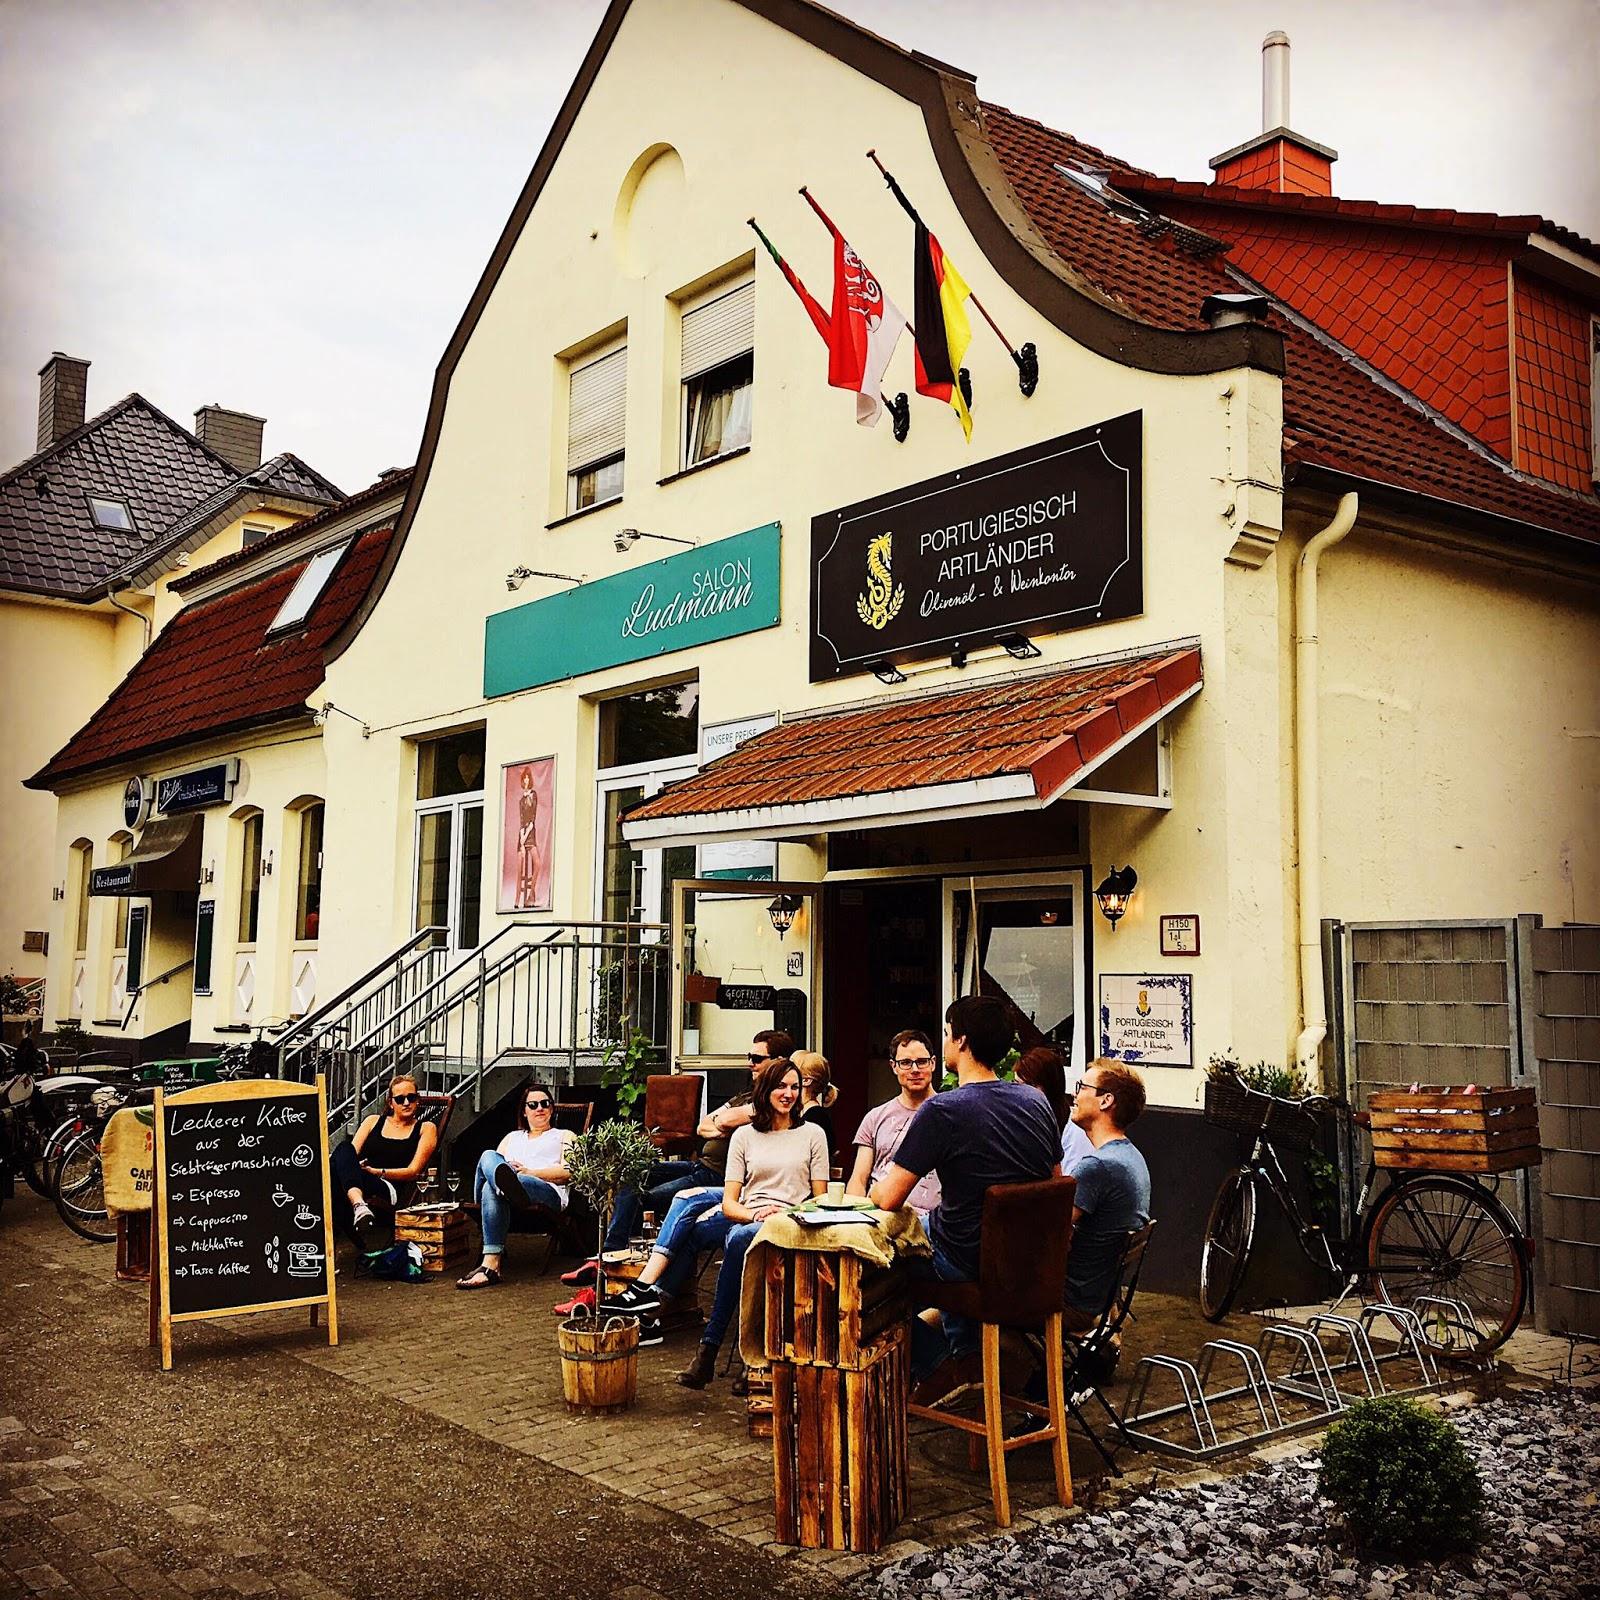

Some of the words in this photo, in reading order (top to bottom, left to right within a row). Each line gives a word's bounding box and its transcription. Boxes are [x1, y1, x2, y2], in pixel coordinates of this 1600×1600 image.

[920, 490, 1077, 555] PORTUGIESISCH
[937, 532, 1055, 583] ARTLÄNDER
[692, 556, 751, 597] SALON
[992, 575, 1004, 597] &
[1010, 562, 1077, 594] Weinkontor
[621, 581, 754, 638] Ludmann
[707, 731, 734, 747] UNSERE
[95, 873, 131, 889] Restaurant
[1168, 919, 1190, 929] H150
[788, 957, 800, 970] 40
[1115, 1018, 1174, 1028] PORTUGIESISCH
[170, 1108, 246, 1136] Leckerer
[256, 1104, 307, 1127] Kaffee
[195, 1138, 221, 1151] aus
[237, 1133, 265, 1148] der
[130, 1167, 153, 1181] CAF
[189, 1188, 241, 1206] Espresso
[189, 1213, 248, 1233] Cappuccino
[191, 1237, 244, 1253] Milchkaffee
[189, 1263, 214, 1276] Tasse
[218, 1262, 251, 1276] Kaffee
[621, 1291, 637, 1302] N
